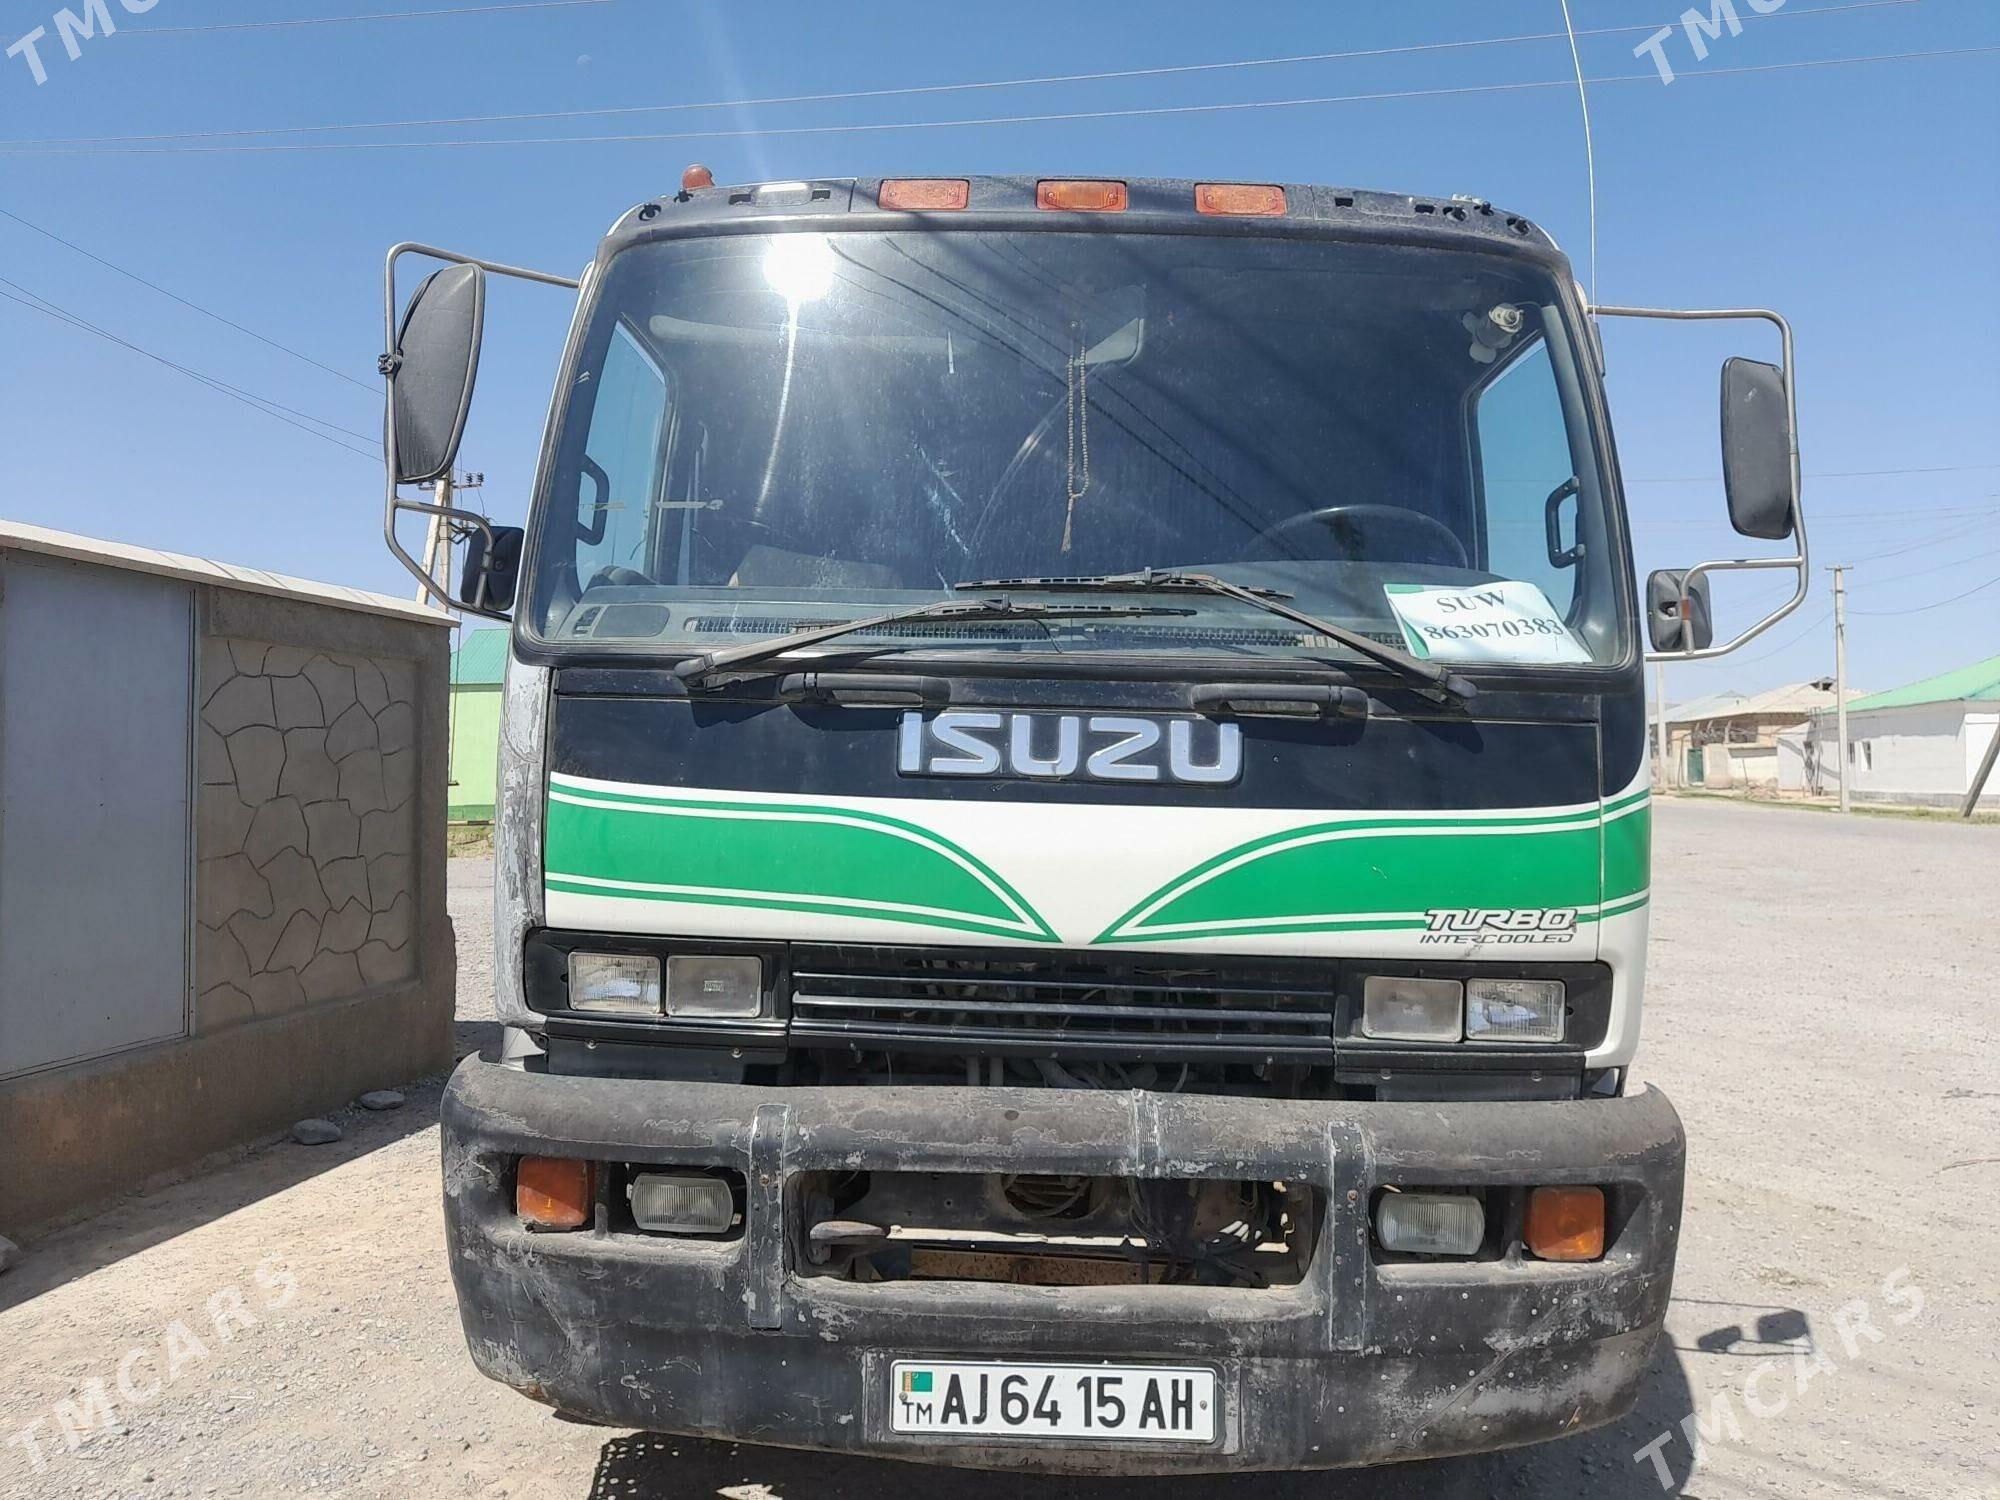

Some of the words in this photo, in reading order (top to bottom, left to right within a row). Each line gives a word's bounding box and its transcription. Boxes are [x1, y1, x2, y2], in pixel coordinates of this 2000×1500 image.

[1436, 590, 1506, 613] SUW
[1424, 618, 1564, 640] 863070383
[900, 711, 1240, 783] ISUZU
[1424, 908, 1578, 932] TURBO
[1420, 933, 1574, 944] INTERCOOLED
[902, 1401, 933, 1424] TM
